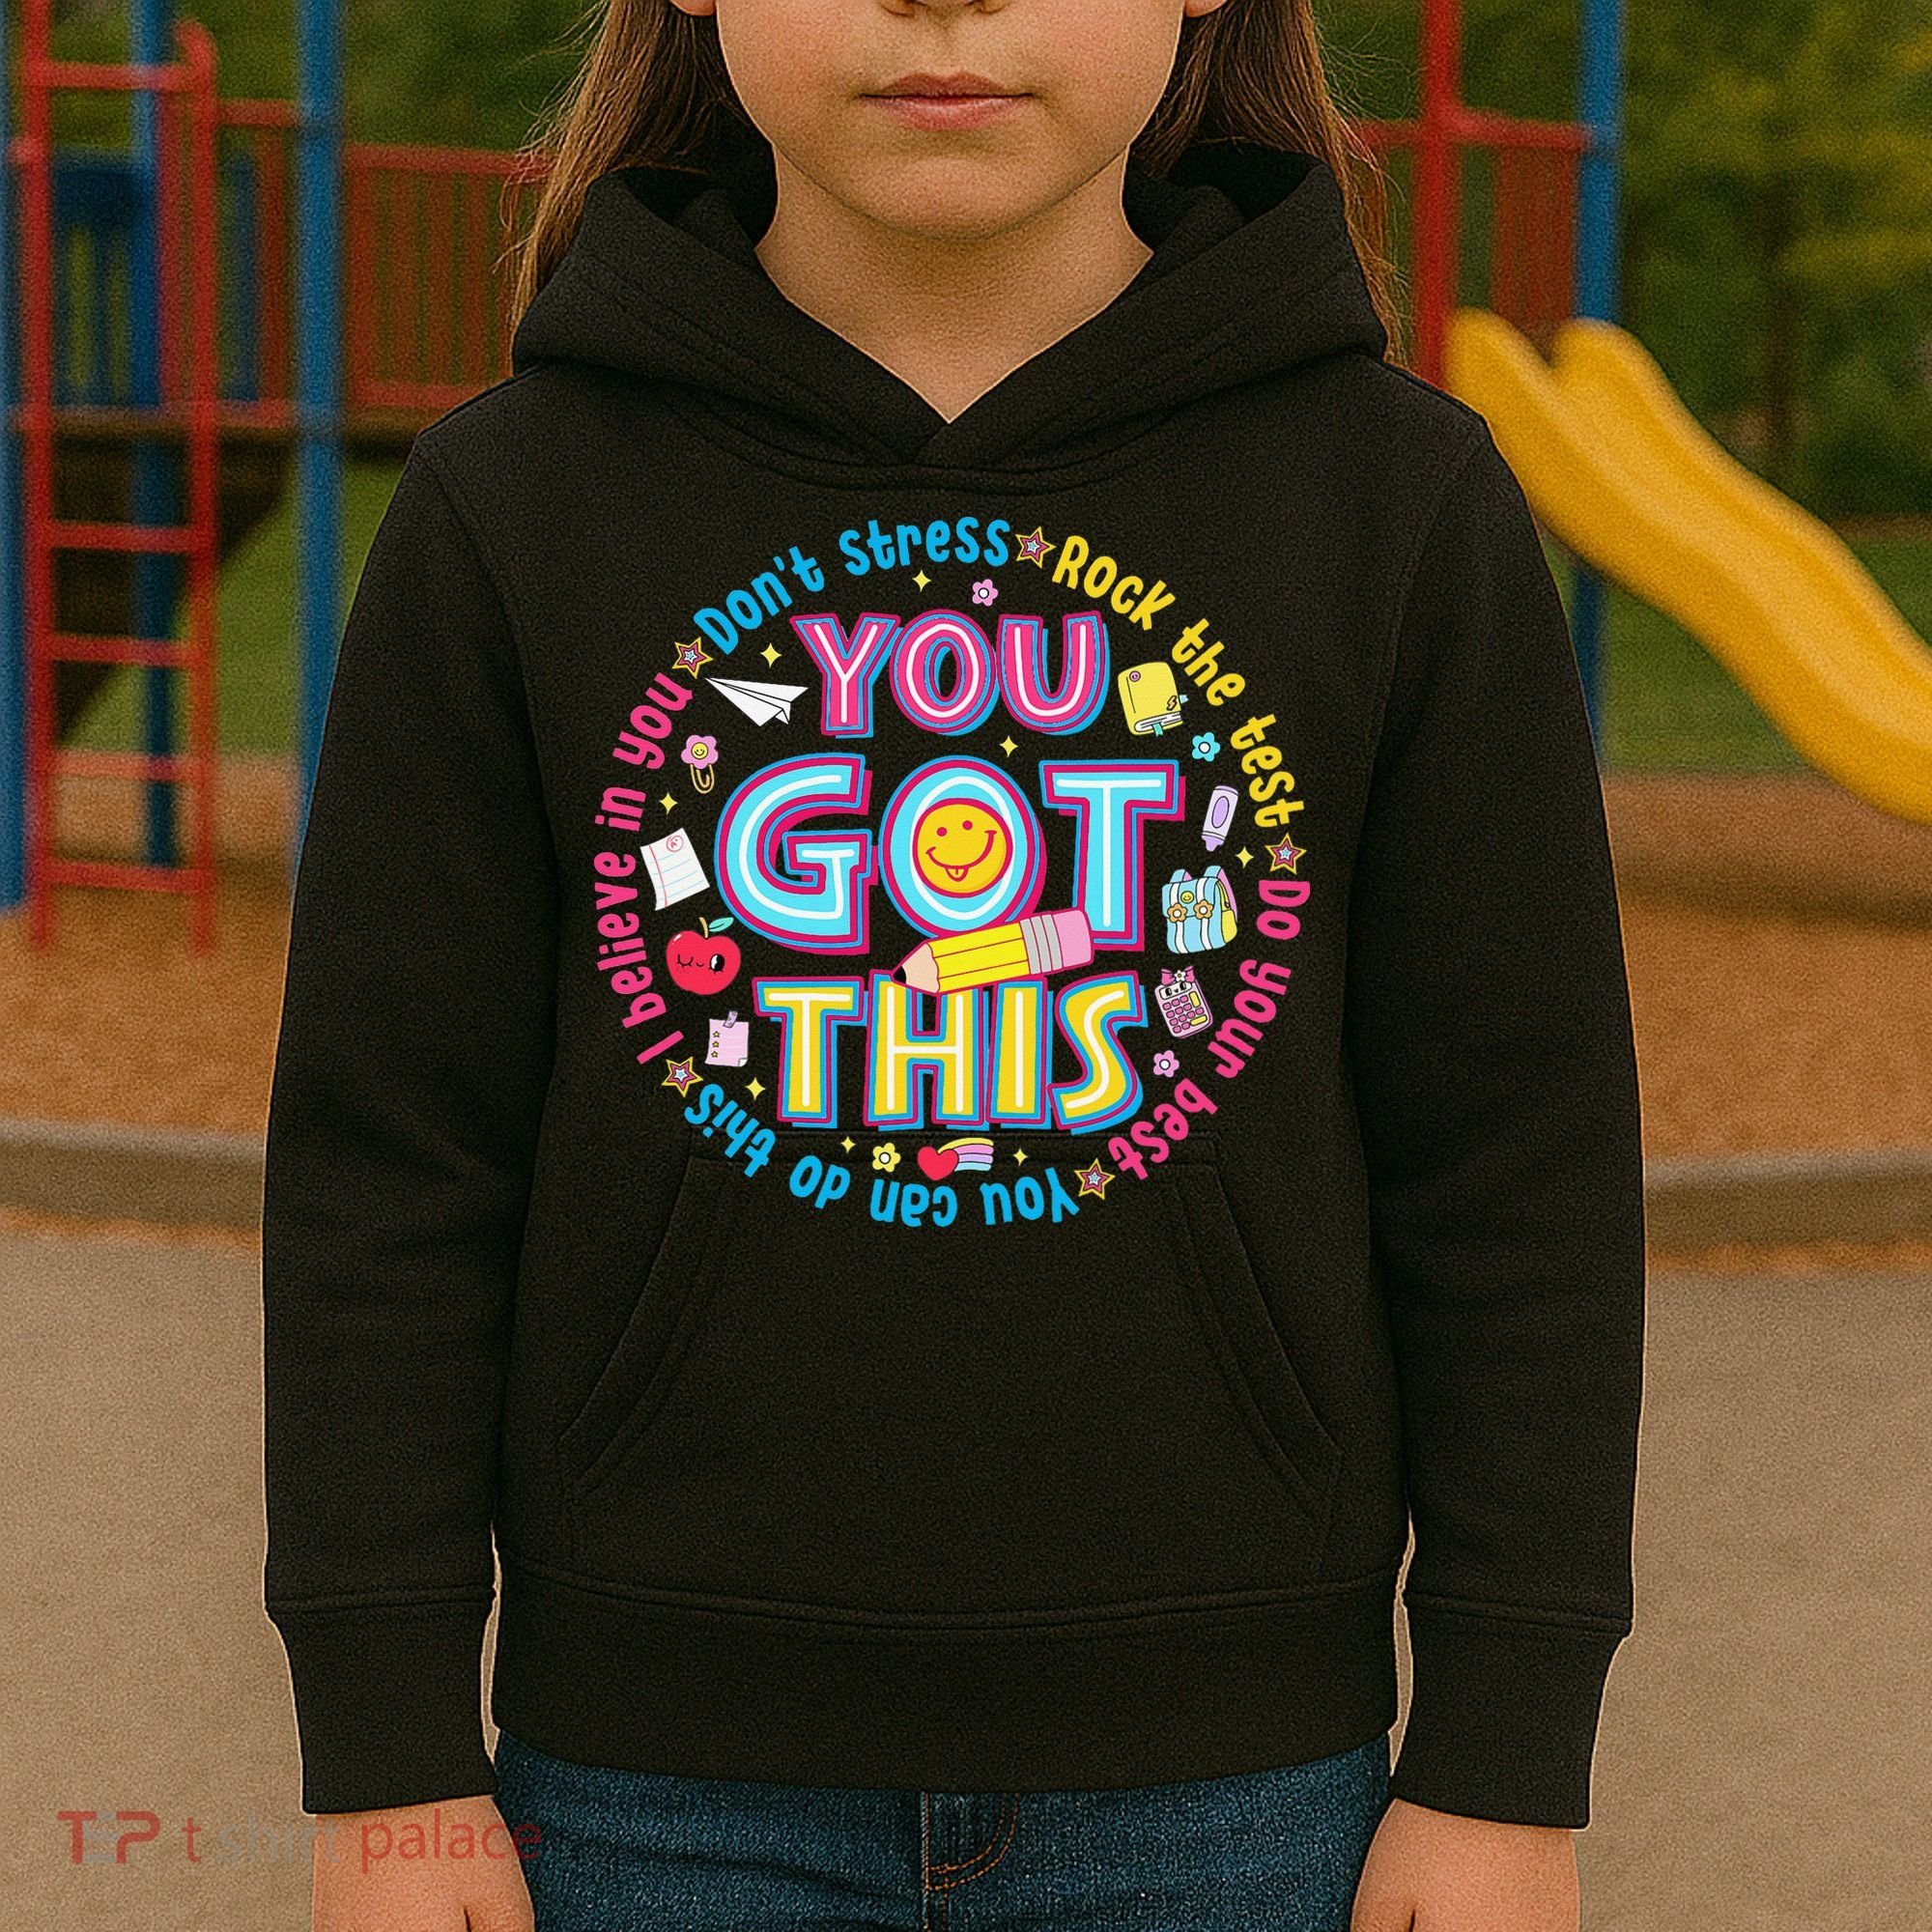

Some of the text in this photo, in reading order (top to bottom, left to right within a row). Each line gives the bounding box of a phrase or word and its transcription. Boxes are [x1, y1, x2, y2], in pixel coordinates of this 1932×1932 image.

[693, 516, 1010, 655] Don't stress
[789, 609, 1110, 739] YOU
[1052, 535, 1305, 828] Rock the test
[593, 672, 694, 1065] I believe in you
[714, 752, 1186, 955] GOT
[752, 969, 1149, 1135] THIS
[1108, 879, 1311, 1179] Do your best
[684, 1083, 1080, 1228] You can do this
